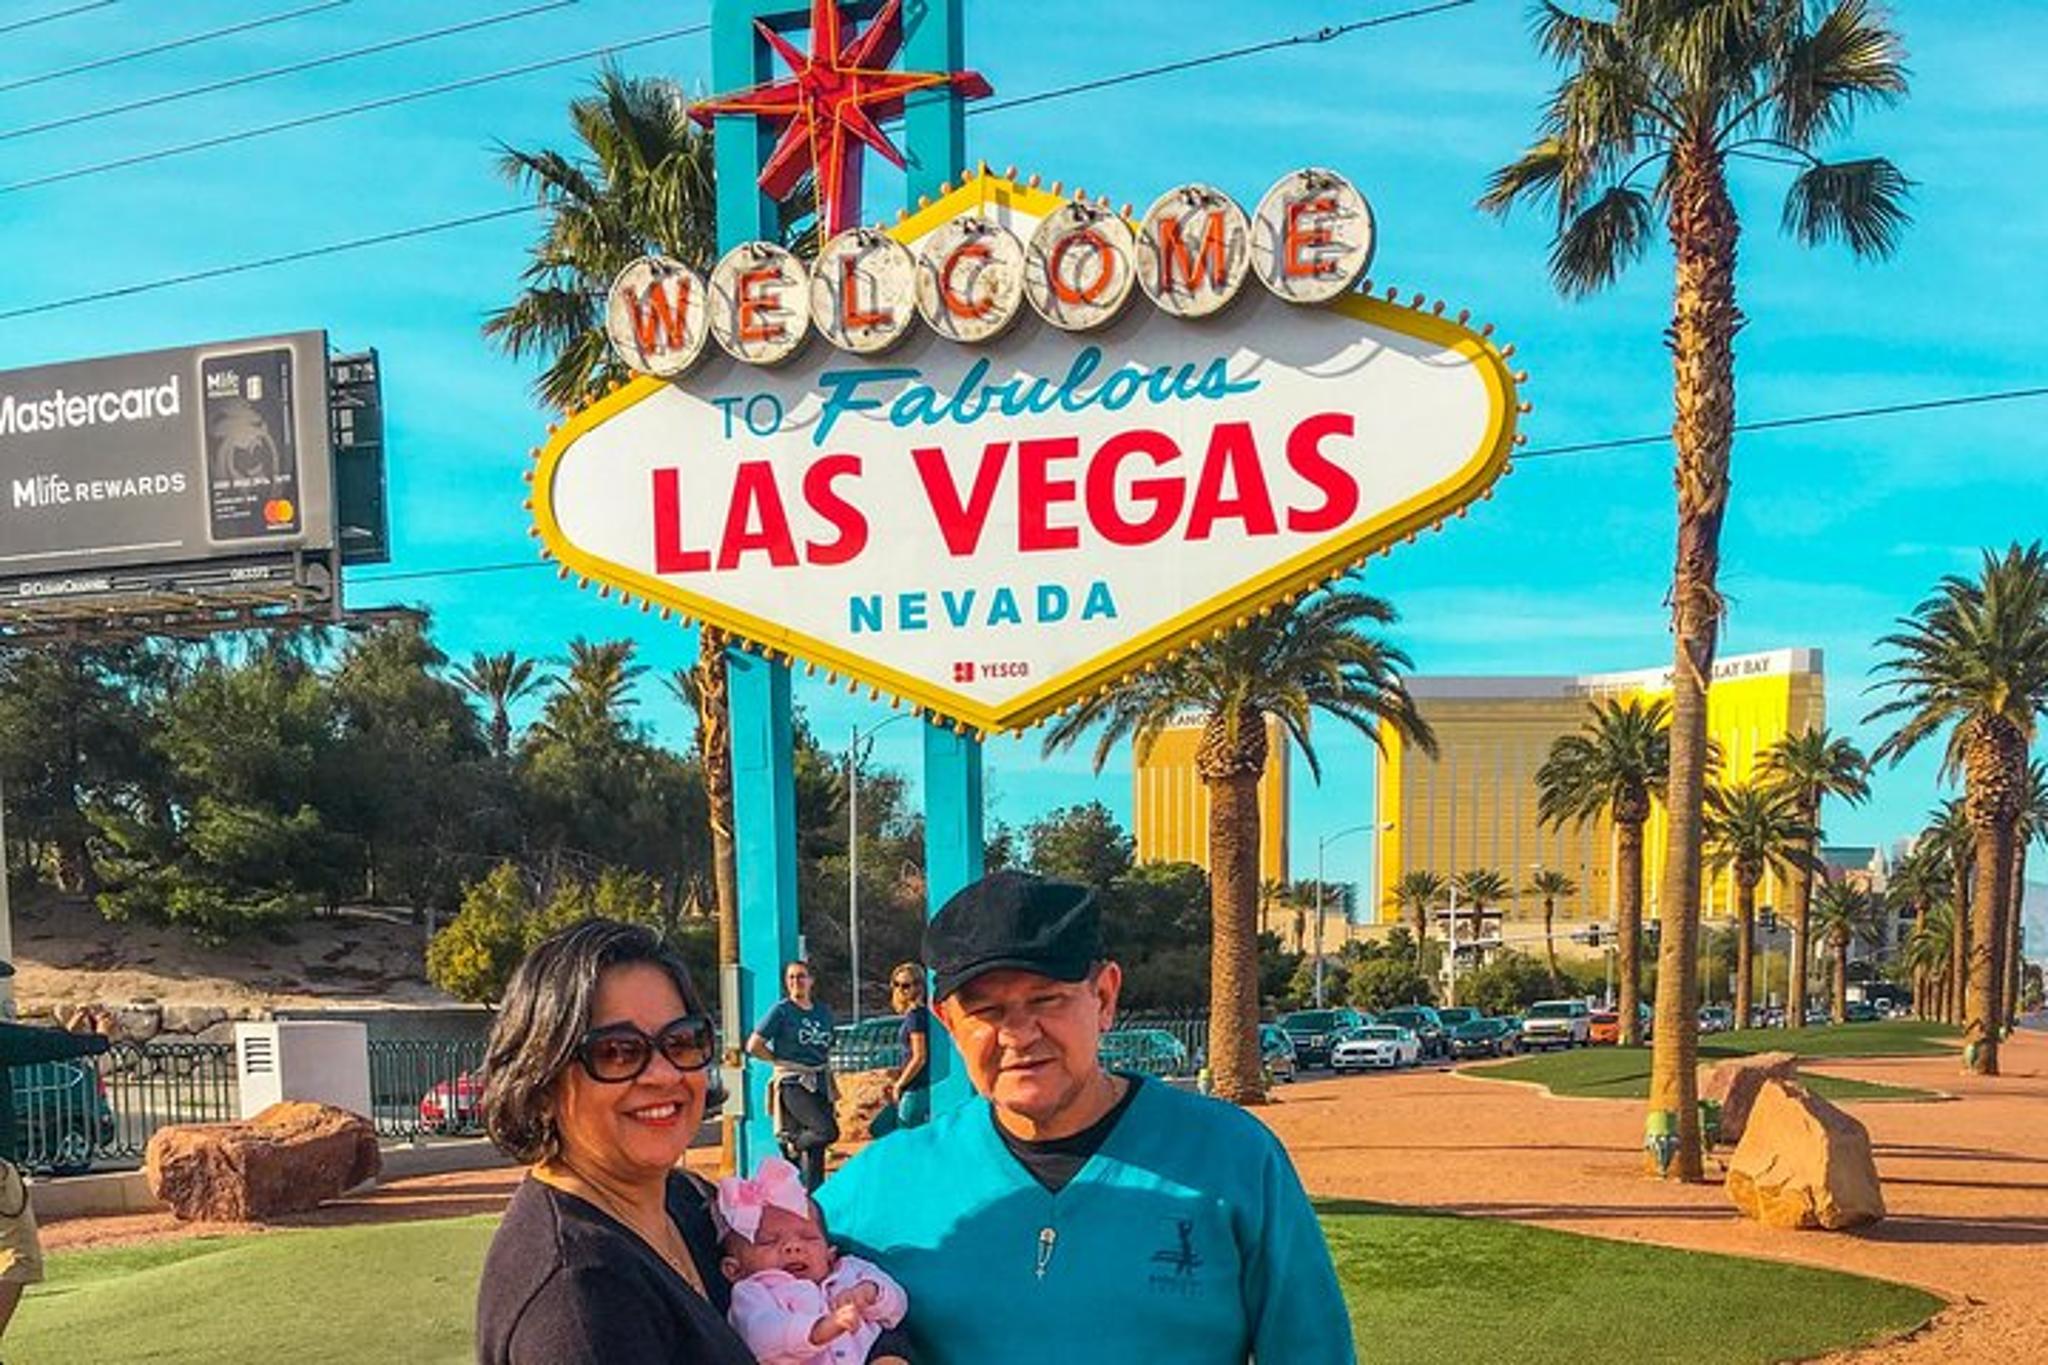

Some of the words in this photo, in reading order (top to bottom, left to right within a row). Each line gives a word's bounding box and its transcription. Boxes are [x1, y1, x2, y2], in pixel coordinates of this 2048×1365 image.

[620, 194, 1340, 360] WELCOME
[715, 394, 783, 439] TO
[812, 346, 1261, 448] Fabulous
[75, 471, 187, 502] REWARDS
[651, 453, 869, 575] LAS
[911, 412, 1360, 557] VEGAS
[849, 581, 1118, 634] NEVADA
[981, 661, 1029, 678] YESCO
